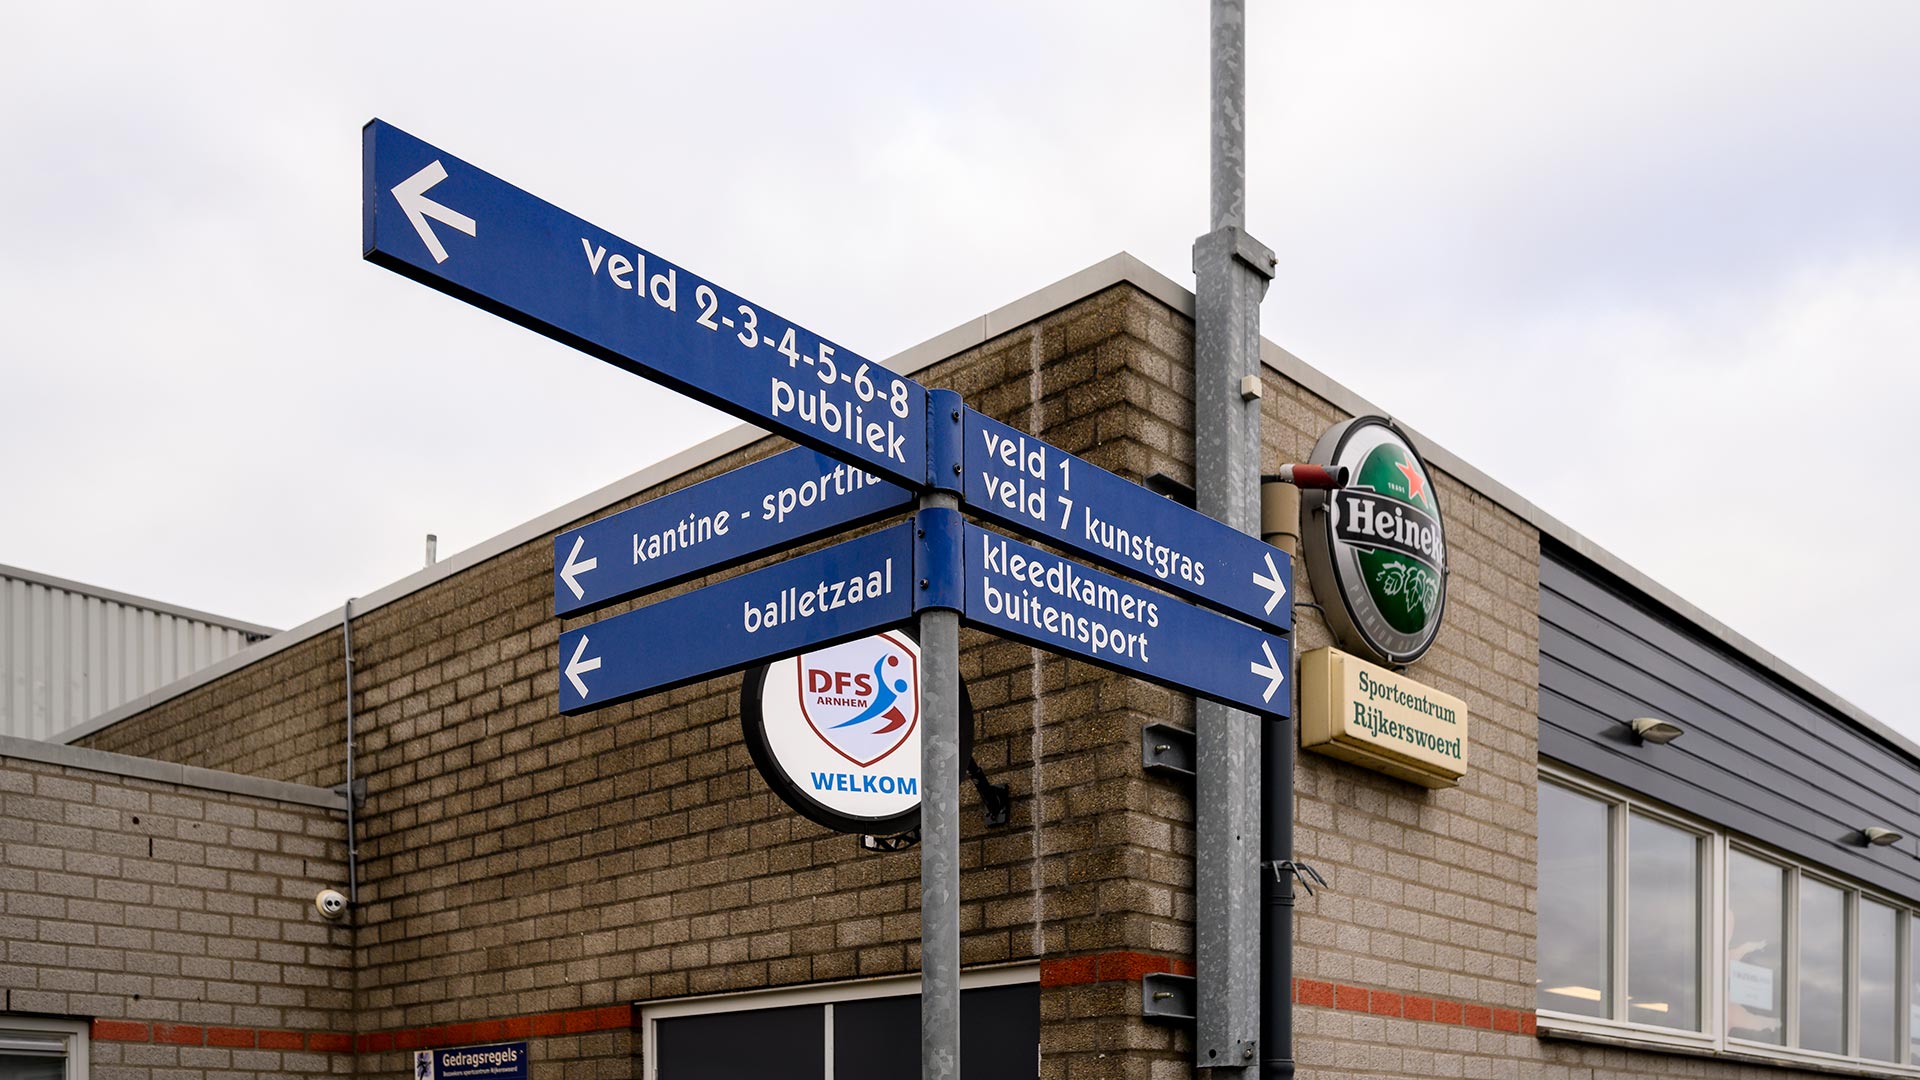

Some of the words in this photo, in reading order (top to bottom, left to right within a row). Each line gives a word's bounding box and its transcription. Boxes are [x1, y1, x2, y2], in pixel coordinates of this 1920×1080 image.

[581, 237, 677, 312] veld
[695, 284, 908, 418] 2-3-4-5-6-8
[770, 376, 906, 463] publiek
[982, 429, 1046, 481] veld
[1058, 457, 1071, 491] 1
[633, 511, 730, 565] kantine
[982, 471, 1046, 522] veld
[1057, 495, 1074, 530] 7
[1085, 506, 1205, 586] kunstgras
[743, 557, 892, 634] balletzaal
[983, 534, 1160, 628] kleedkamers
[983, 576, 1149, 663] buitensport
[808, 668, 873, 697] DFS
[816, 696, 868, 709] ARNHEM
[1359, 670, 1457, 725] Sportcentrum
[1353, 700, 1462, 760] Rijkerswoerd
[810, 771, 918, 796] WELKOM
[442, 1047, 518, 1068] Gedragsregels
